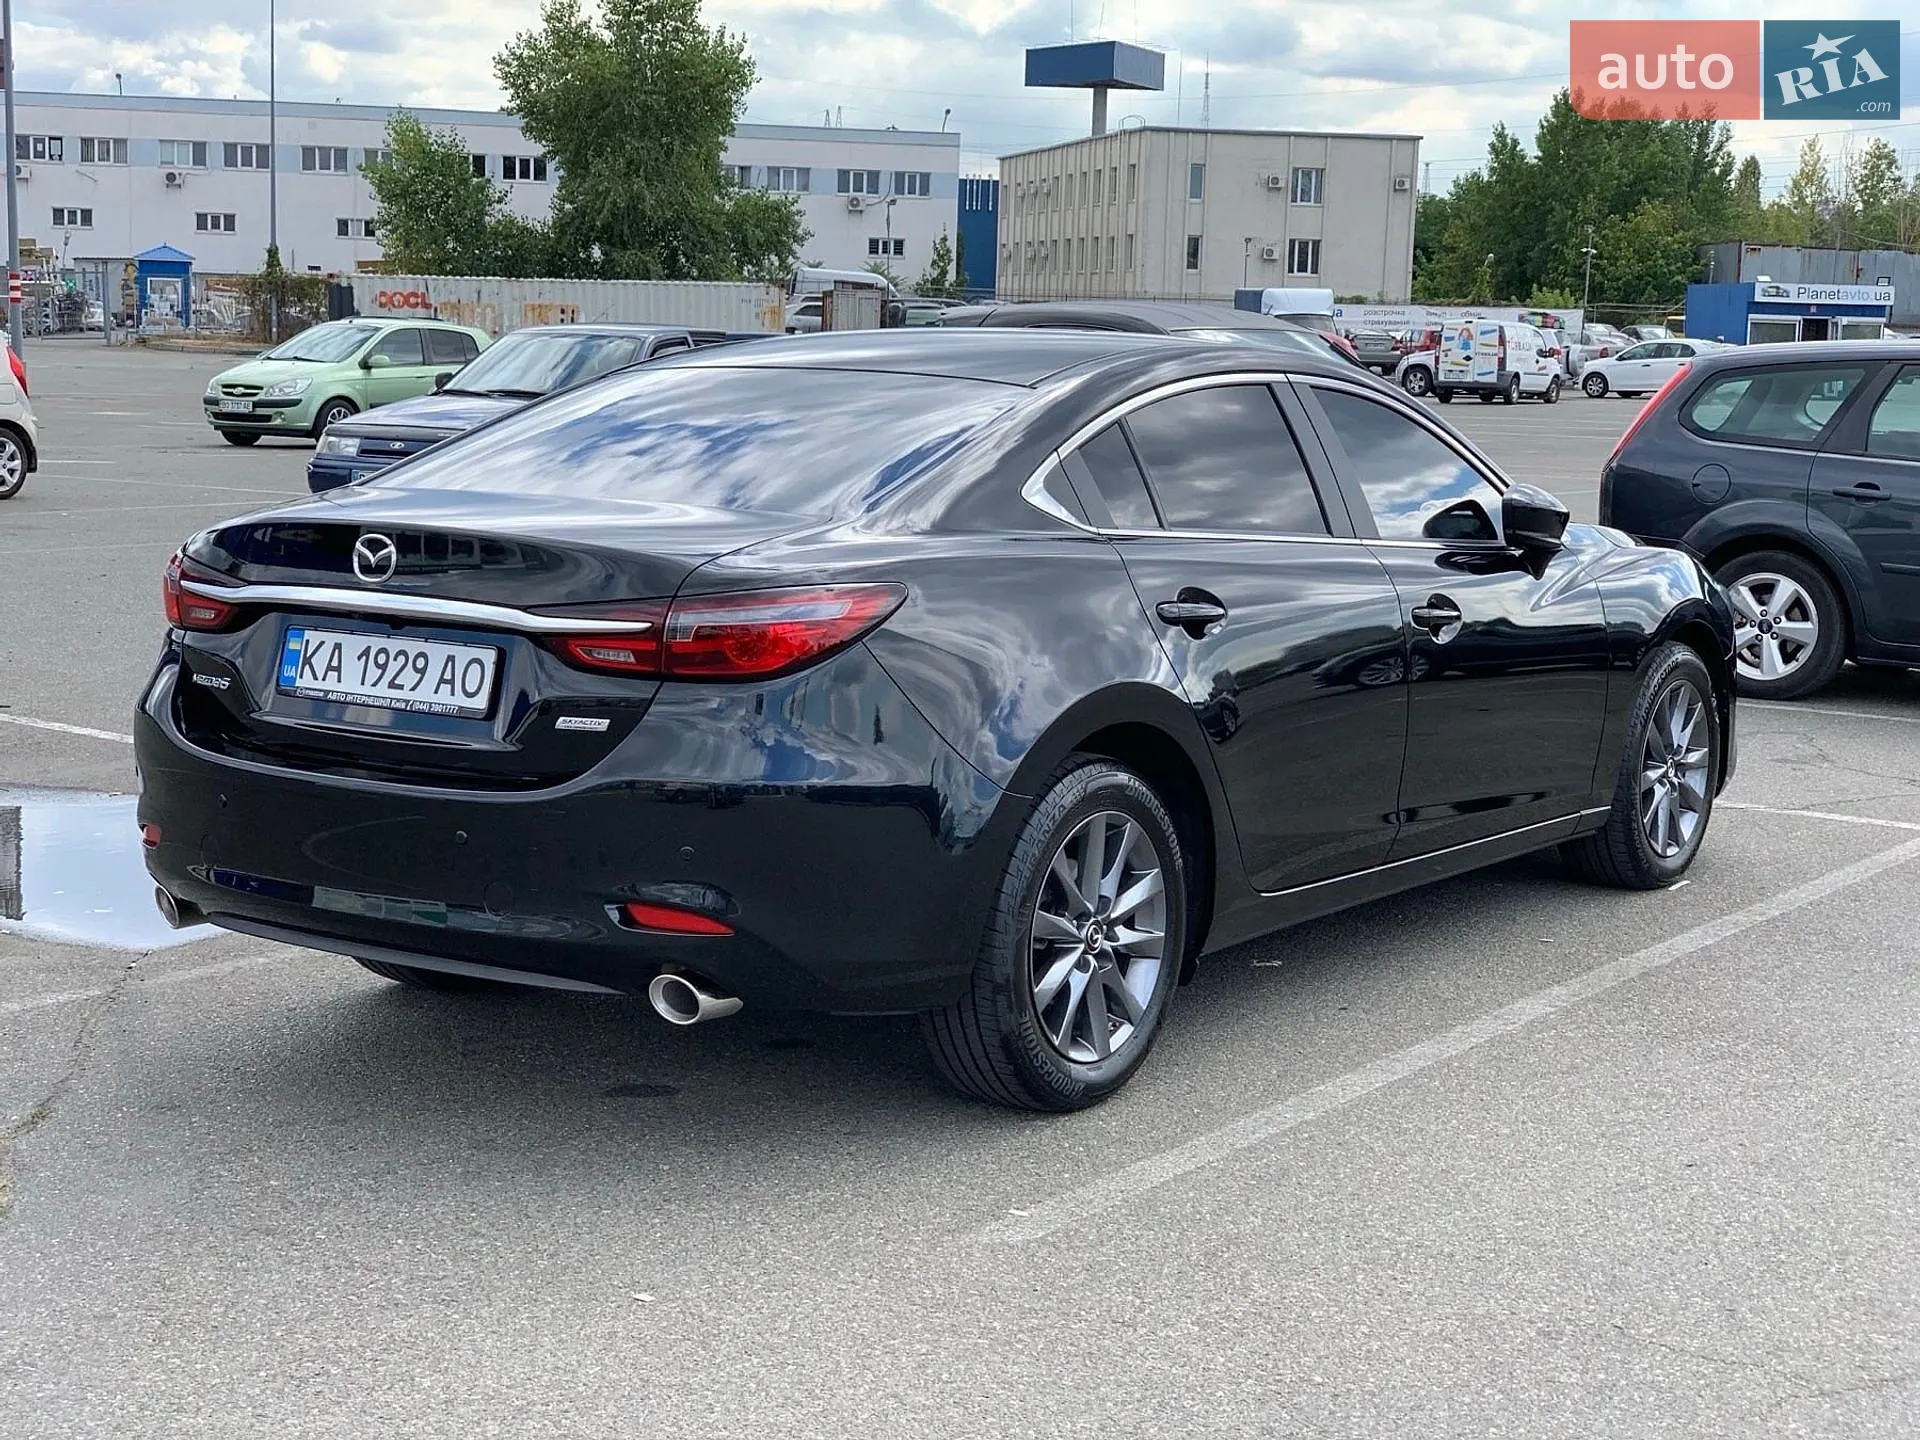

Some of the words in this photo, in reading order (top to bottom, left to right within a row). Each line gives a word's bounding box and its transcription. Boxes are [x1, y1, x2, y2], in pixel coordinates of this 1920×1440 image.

[1797, 287, 1891, 301] Planetavto.ua
[284, 666, 296, 678] UA
[299, 639, 344, 684] KA
[356, 645, 429, 692] 1929
[433, 654, 486, 699] AO
[327, 691, 346, 701] АВТО
[1124, 778, 1184, 871] BRIDGESTONE
